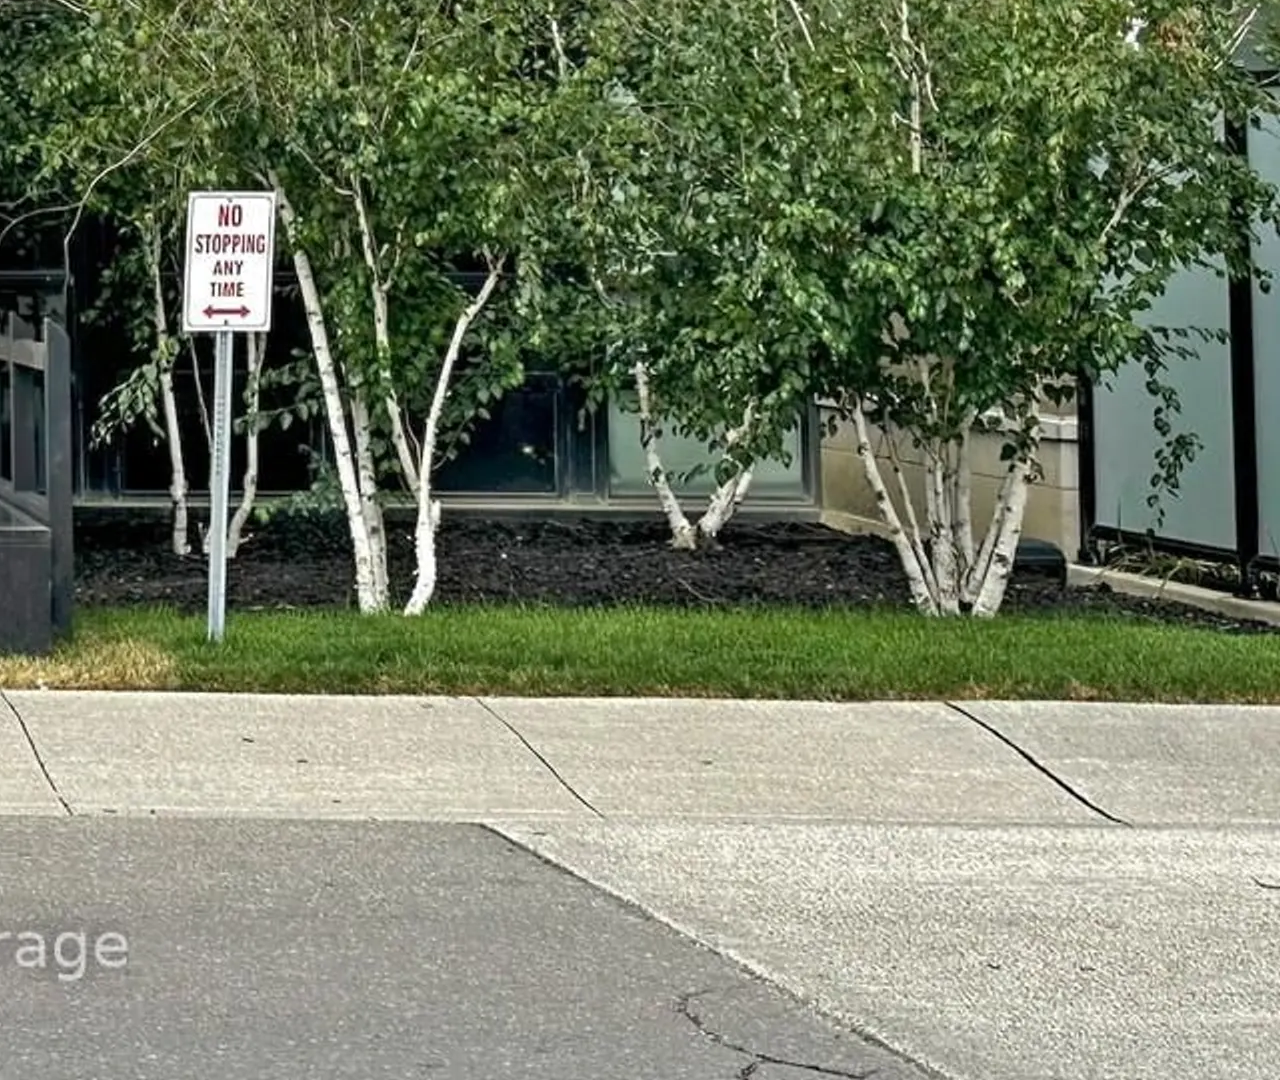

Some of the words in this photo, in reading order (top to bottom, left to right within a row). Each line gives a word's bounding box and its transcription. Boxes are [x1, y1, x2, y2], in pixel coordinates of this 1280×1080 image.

[218, 204, 243, 227] NO
[194, 233, 266, 254] STOPPING
[213, 260, 244, 276] ANY
[210, 281, 244, 297] TIME
